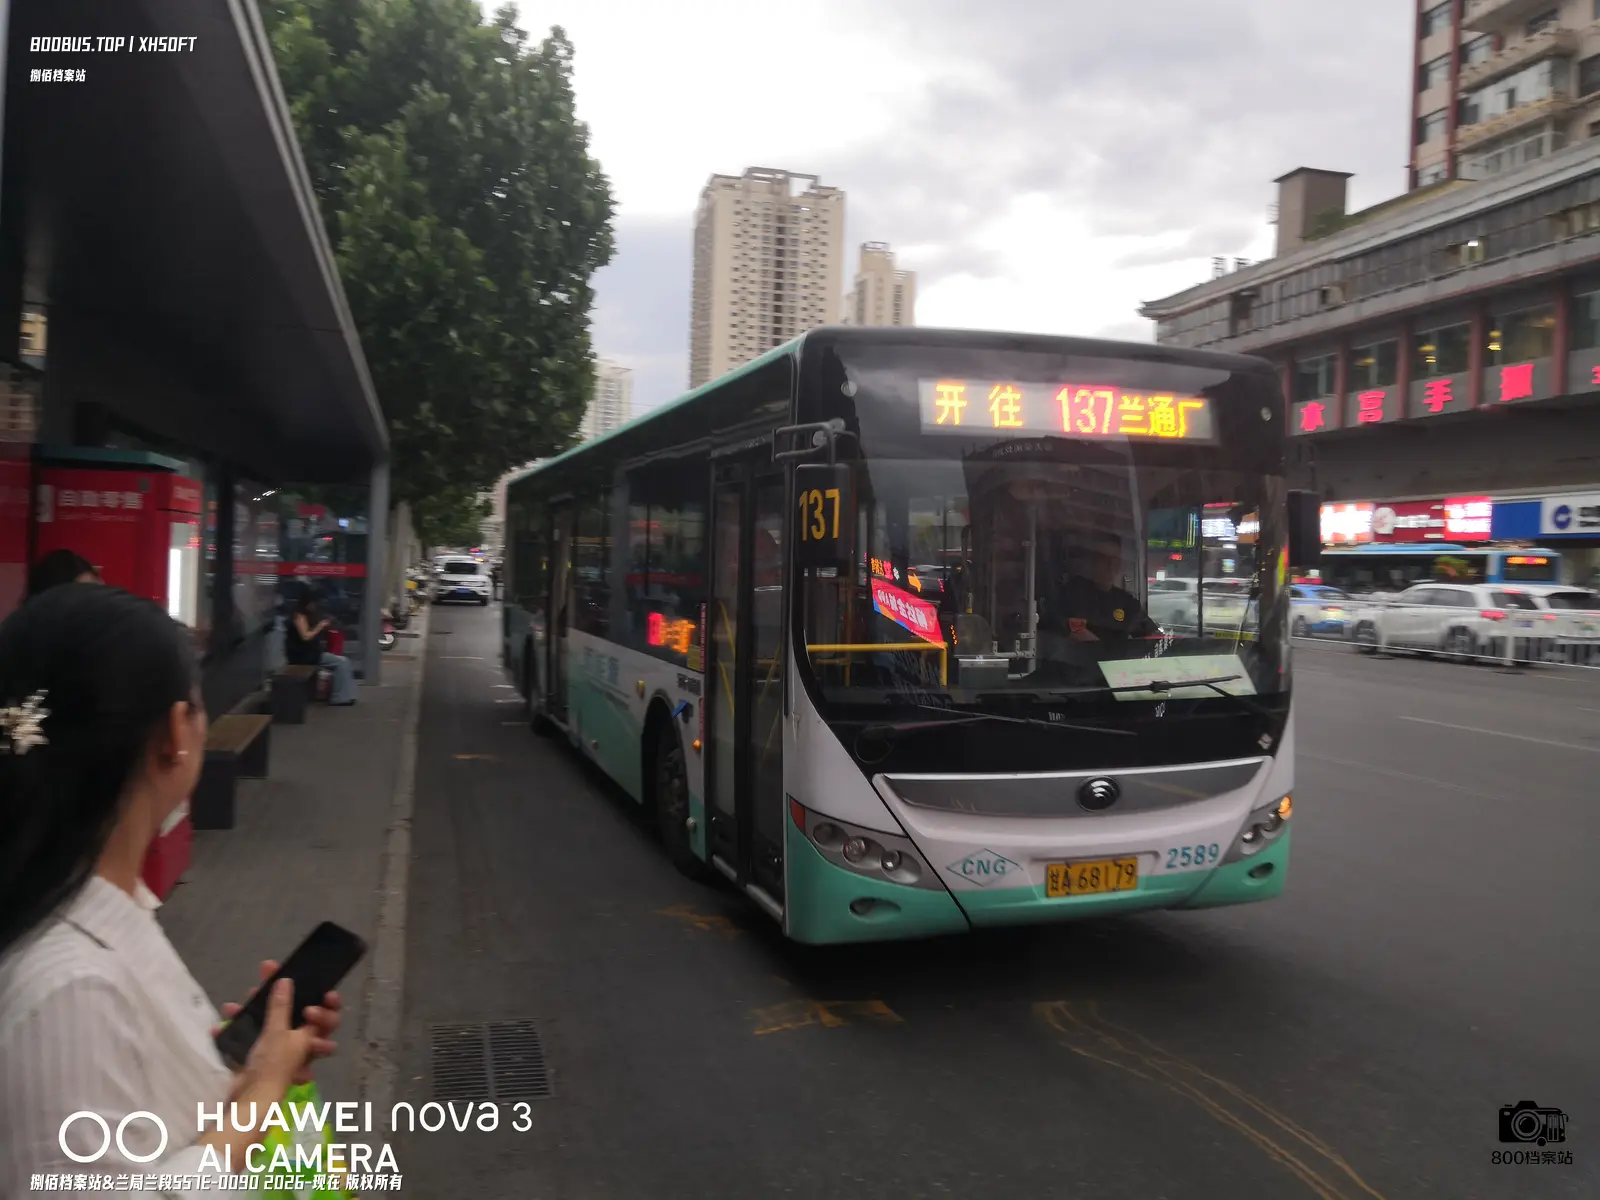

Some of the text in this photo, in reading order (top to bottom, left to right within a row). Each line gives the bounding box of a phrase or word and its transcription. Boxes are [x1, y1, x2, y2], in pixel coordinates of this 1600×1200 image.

[799, 488, 840, 541] 137
[961, 858, 1006, 876] CNG
[1165, 843, 1220, 869] 2589
